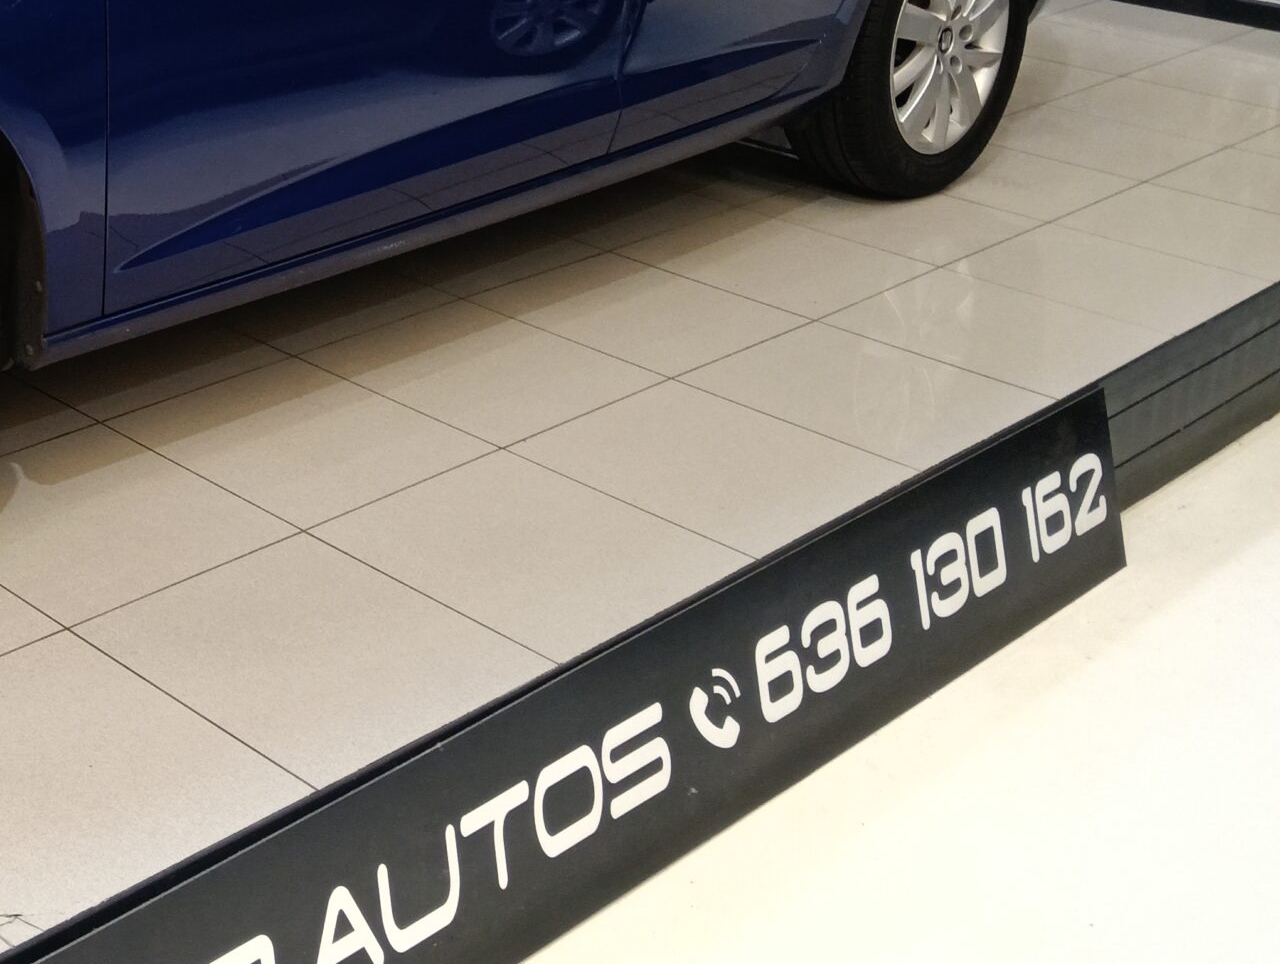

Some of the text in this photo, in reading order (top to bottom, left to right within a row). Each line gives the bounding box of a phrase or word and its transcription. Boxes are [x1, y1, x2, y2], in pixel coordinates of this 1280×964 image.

[316, 453, 1107, 964] AUTOS 636 130 162
